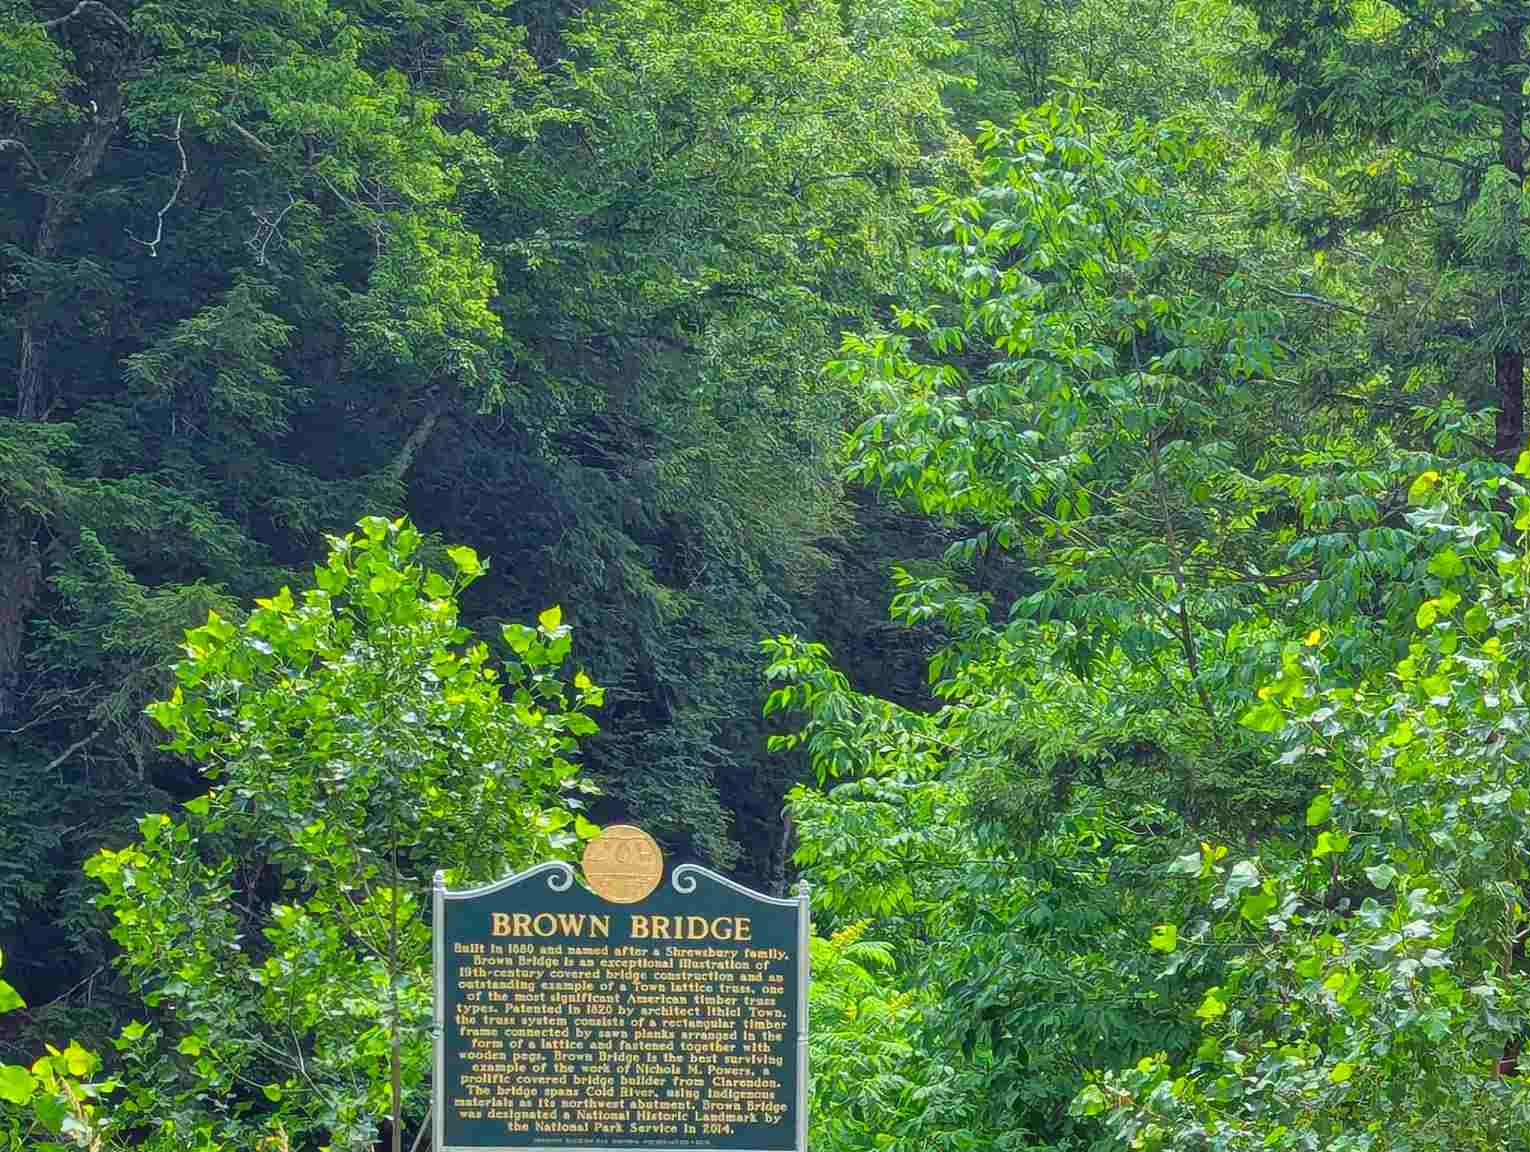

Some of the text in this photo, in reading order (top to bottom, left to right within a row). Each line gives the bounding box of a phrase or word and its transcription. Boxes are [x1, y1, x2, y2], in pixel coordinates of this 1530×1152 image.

[491, 912, 752, 941] BROWN BRIDGE
[453, 943, 485, 954] Built
[491, 943, 503, 954] in
[540, 944, 562, 955] and
[567, 945, 608, 956] named
[613, 945, 649, 956] after
[653, 948, 660, 956] a
[665, 946, 738, 960] Shrewsbury
[473, 955, 770, 971] Brown Bridge is an exceptional illustration of
[550, 968, 600, 979] covered
[606, 969, 647, 983] bridge
[654, 970, 734, 981] construction
[740, 971, 763, 982] and
[768, 974, 784, 982] an
[457, 979, 535, 993] outstanding
[541, 980, 593, 994] example
[600, 981, 615, 992] of
[619, 983, 627, 992] a
[633, 982, 665, 992] Town
[671, 982, 713, 993] lattice
[761, 986, 785, 994] one
[466, 991, 776, 1006] of the most significant American timber truss
[456, 1004, 498, 1017] types.
[505, 1004, 562, 1015] Patented
[568, 1005, 581, 1015] in
[618, 1006, 634, 1019] by
[640, 1006, 700, 1017] architect
[707, 1007, 741, 1017] Ithiel
[455, 1015, 787, 1031] the truss system consists of a rectangular timber
[460, 1027, 784, 1043] frame connected by sawn planks arranged in the
[471, 1039, 770, 1055] form of a lattice and fastened together with
[458, 1050, 784, 1067] wooden pegs. Brown Bridge is the best surviving
[471, 1062, 528, 1076] example
[532, 1063, 546, 1074] of
[553, 1063, 575, 1074] the
[581, 1064, 610, 1074] work
[616, 1064, 630, 1074] of
[687, 1065, 703, 1075] M.
[762, 1068, 770, 1076] a
[460, 1073, 781, 1088] prolific covered bridge builder from Clarendon.
[467, 1085, 490, 1096] The
[496, 1086, 538, 1099] bridge
[544, 1088, 579, 1099] spans
[585, 1087, 615, 1097] Cold
[666, 1088, 700, 1101] using
[707, 1088, 775, 1102] indigenous
[453, 1097, 788, 1114] materials as its northwest abutment. Brown Bridge
[459, 1109, 783, 1125] was designated a National Historic Landmark by
[507, 1121, 735, 1134] the National Park Service in 2014.
